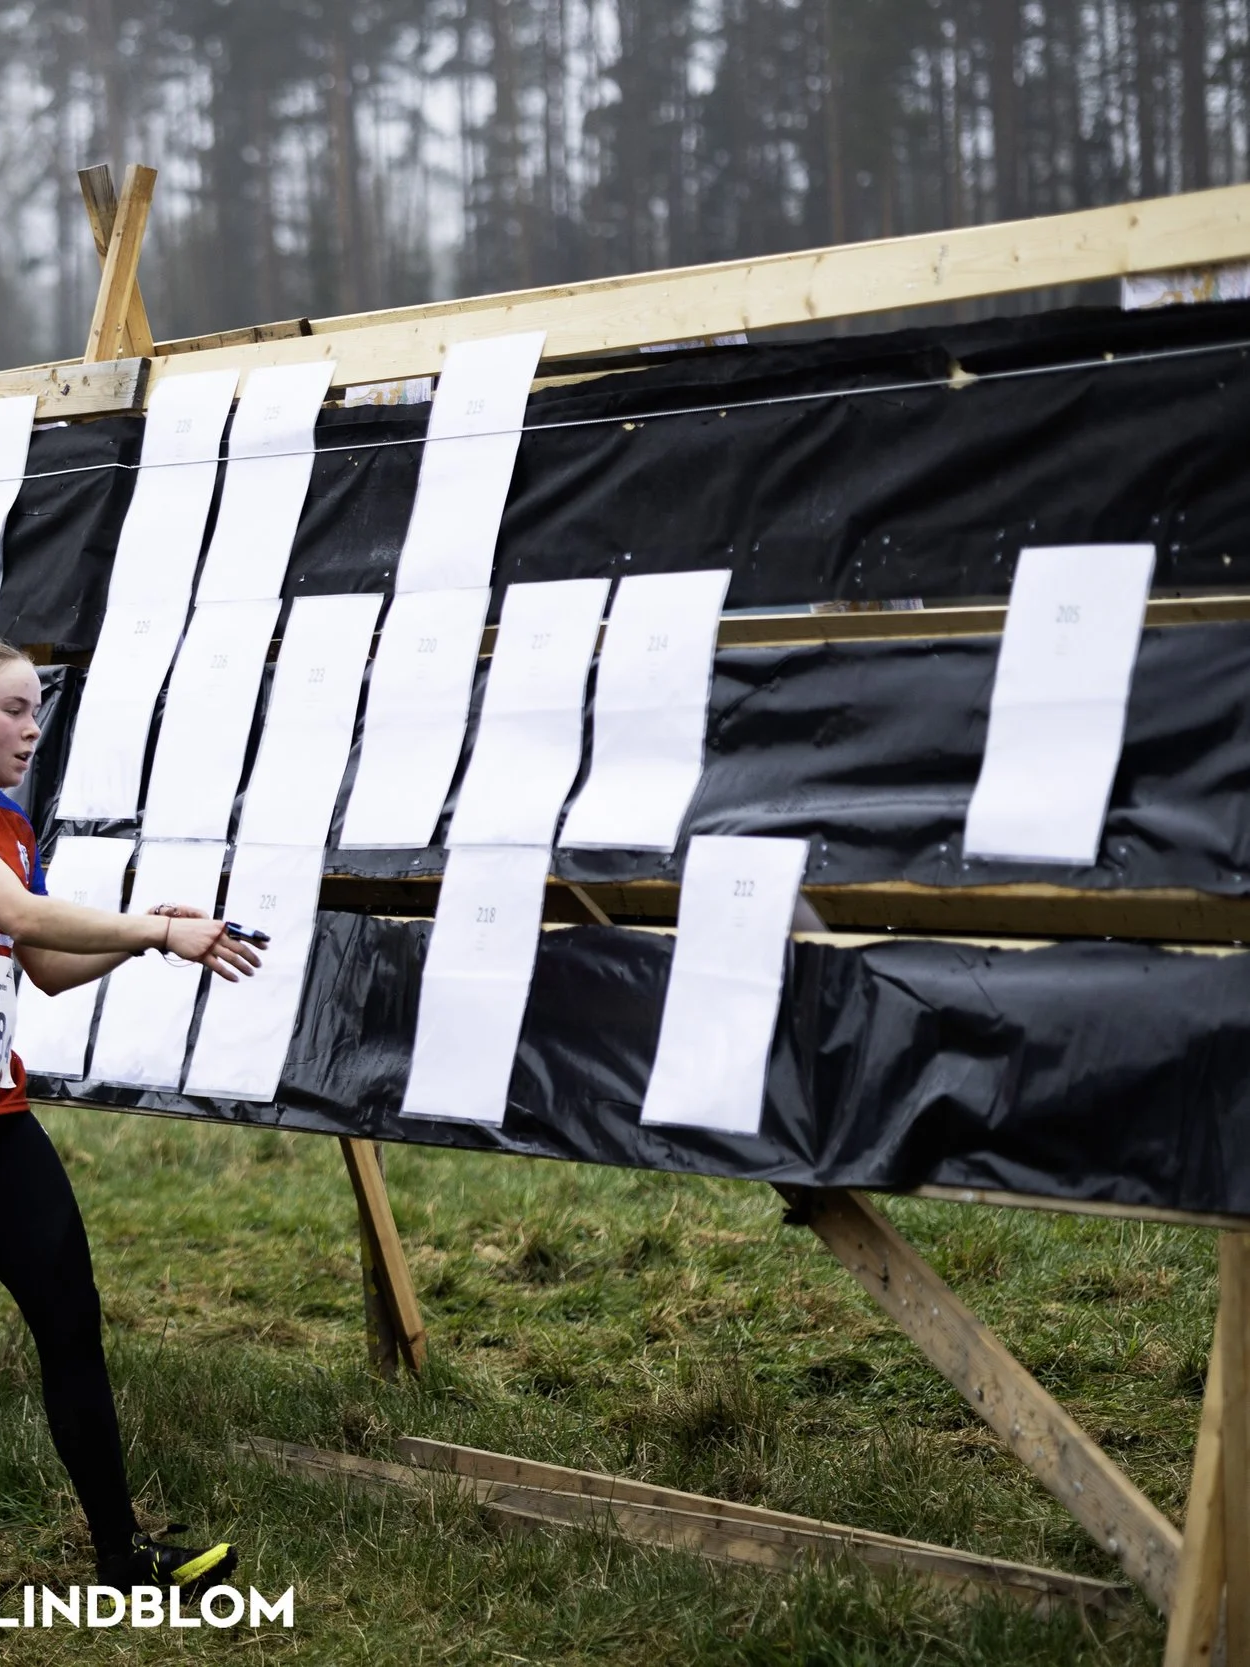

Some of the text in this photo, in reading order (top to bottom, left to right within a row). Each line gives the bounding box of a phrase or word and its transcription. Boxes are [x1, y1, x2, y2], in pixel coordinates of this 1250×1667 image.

[262, 405, 282, 422] 225
[465, 398, 486, 416] 219
[1055, 604, 1082, 624] 205
[417, 637, 438, 654] 220
[646, 633, 669, 652] 214
[307, 666, 327, 684] 223
[733, 879, 756, 898] 212
[259, 893, 278, 911] 224
[476, 906, 498, 924] 218
